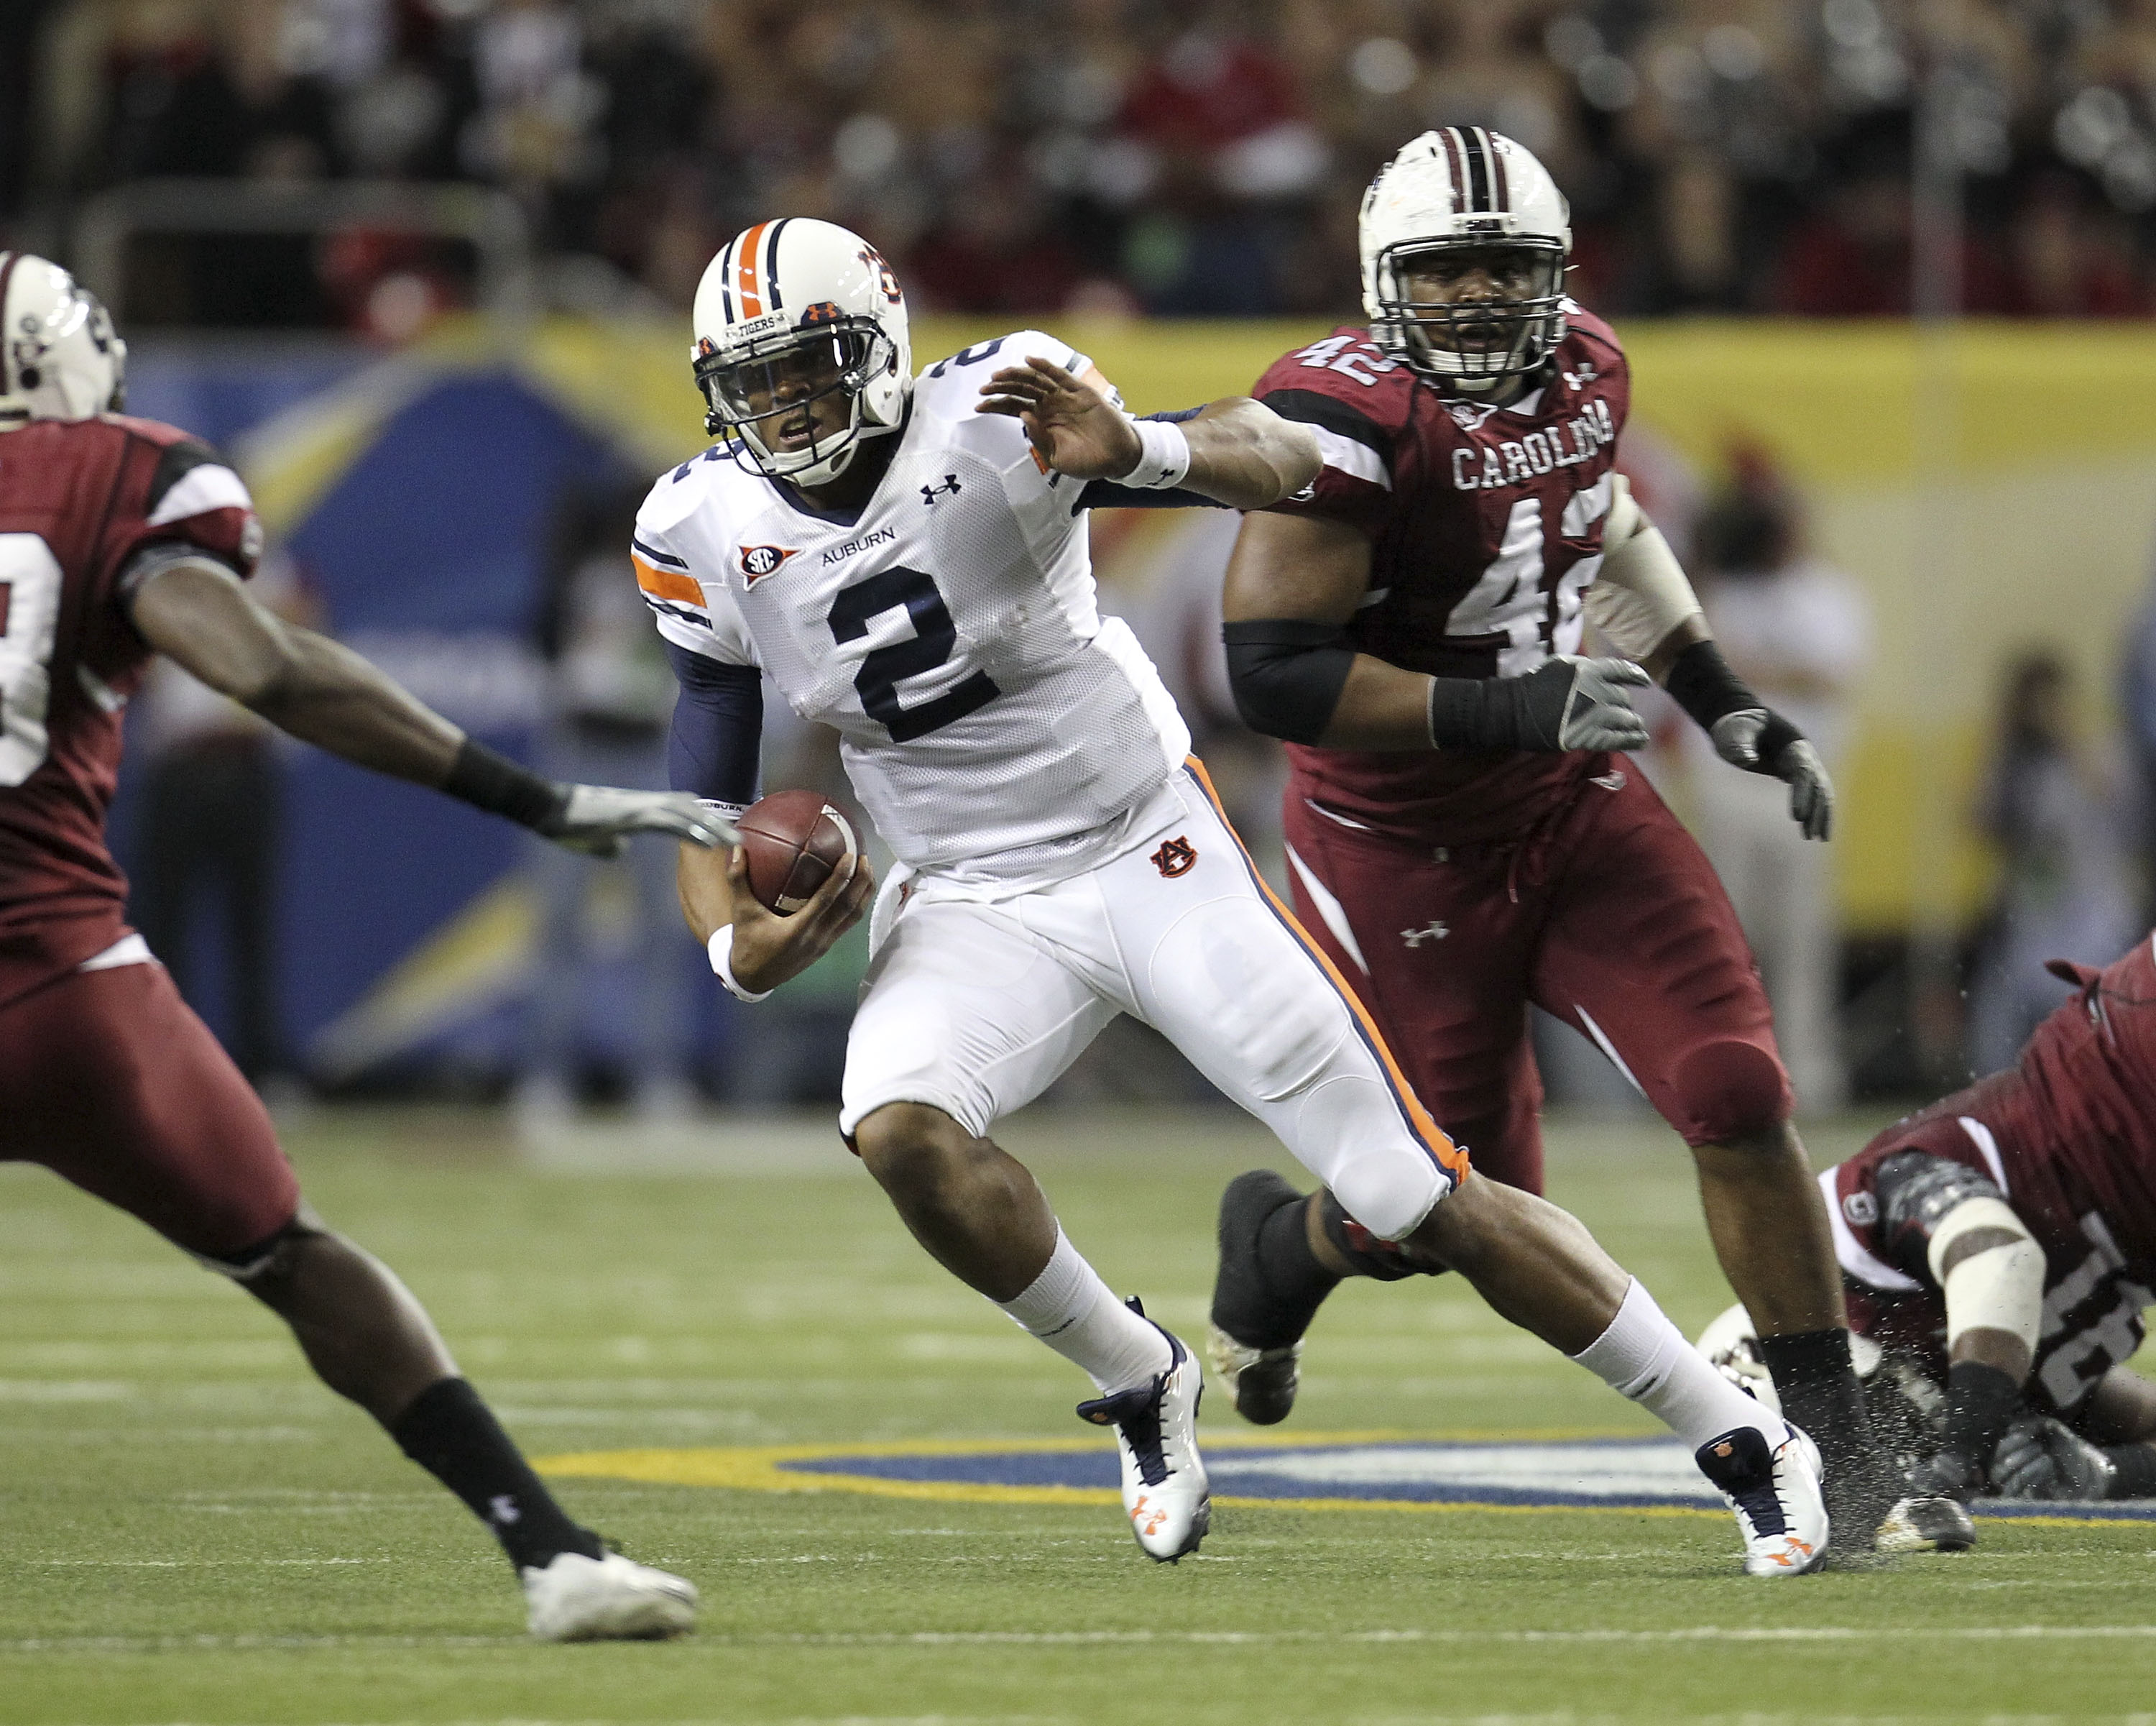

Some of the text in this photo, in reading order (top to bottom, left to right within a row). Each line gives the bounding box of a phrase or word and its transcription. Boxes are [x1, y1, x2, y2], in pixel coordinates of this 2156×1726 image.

[739, 317, 775, 336] TIGERS
[747, 548, 775, 573] SEC
[822, 527, 895, 567] AUBURN
[827, 566, 1001, 743] 2
